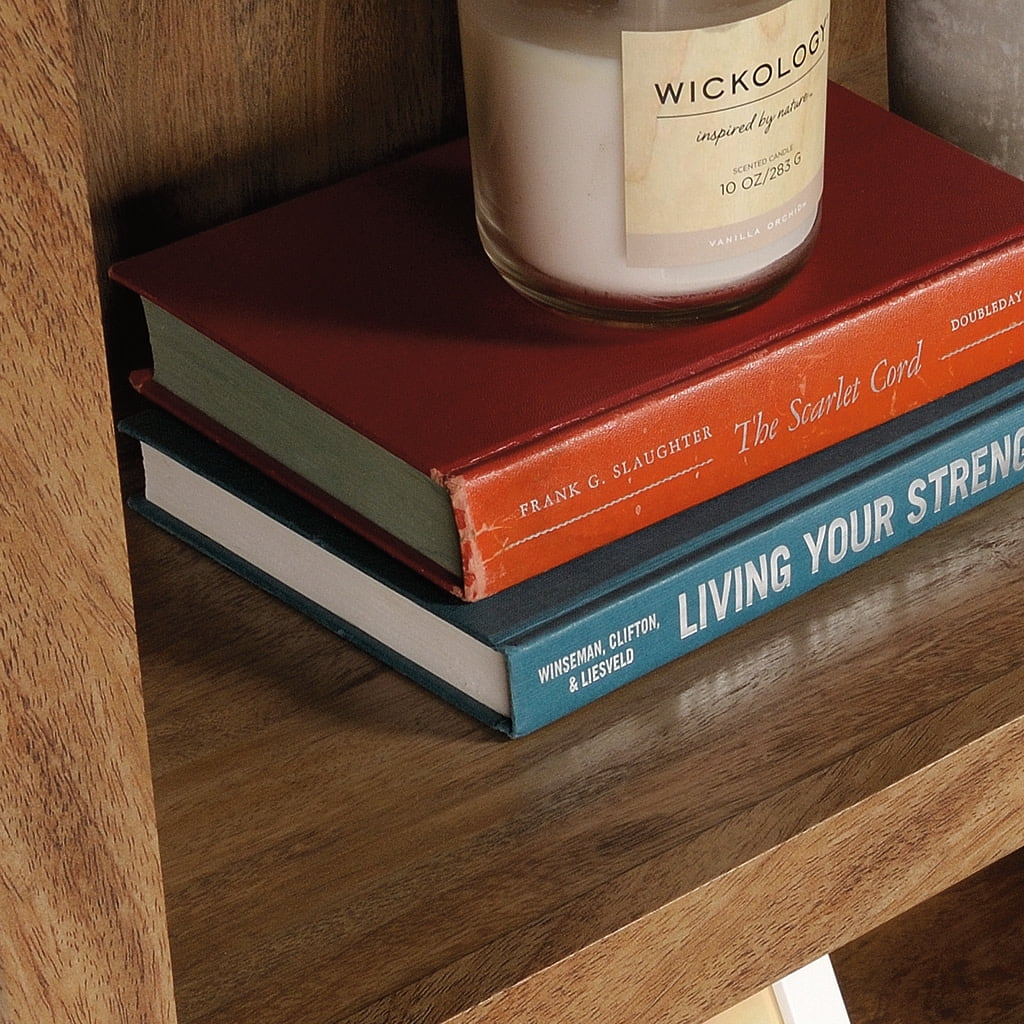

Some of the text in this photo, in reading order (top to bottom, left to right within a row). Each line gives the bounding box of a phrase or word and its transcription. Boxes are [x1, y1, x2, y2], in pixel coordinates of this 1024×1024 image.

[654, 17, 828, 105] WICKOLOGY
[696, 113, 757, 146] inspired
[758, 111, 775, 134] by
[720, 181, 737, 196] 10
[793, 151, 801, 166] G
[732, 144, 794, 175] SCENTED CANDLE
[709, 228, 761, 248] VANILLA
[950, 290, 1024, 332] DOUBLEDAY
[733, 338, 925, 455] The Scarlet Cord
[519, 425, 713, 518] FRANK G. SLAUGHTER
[678, 544, 792, 640] LIVING
[802, 495, 895, 575] YOUR
[538, 613, 660, 684] WINSEMAN, CLIFTON,
[569, 648, 635, 693] & LIESVELD
